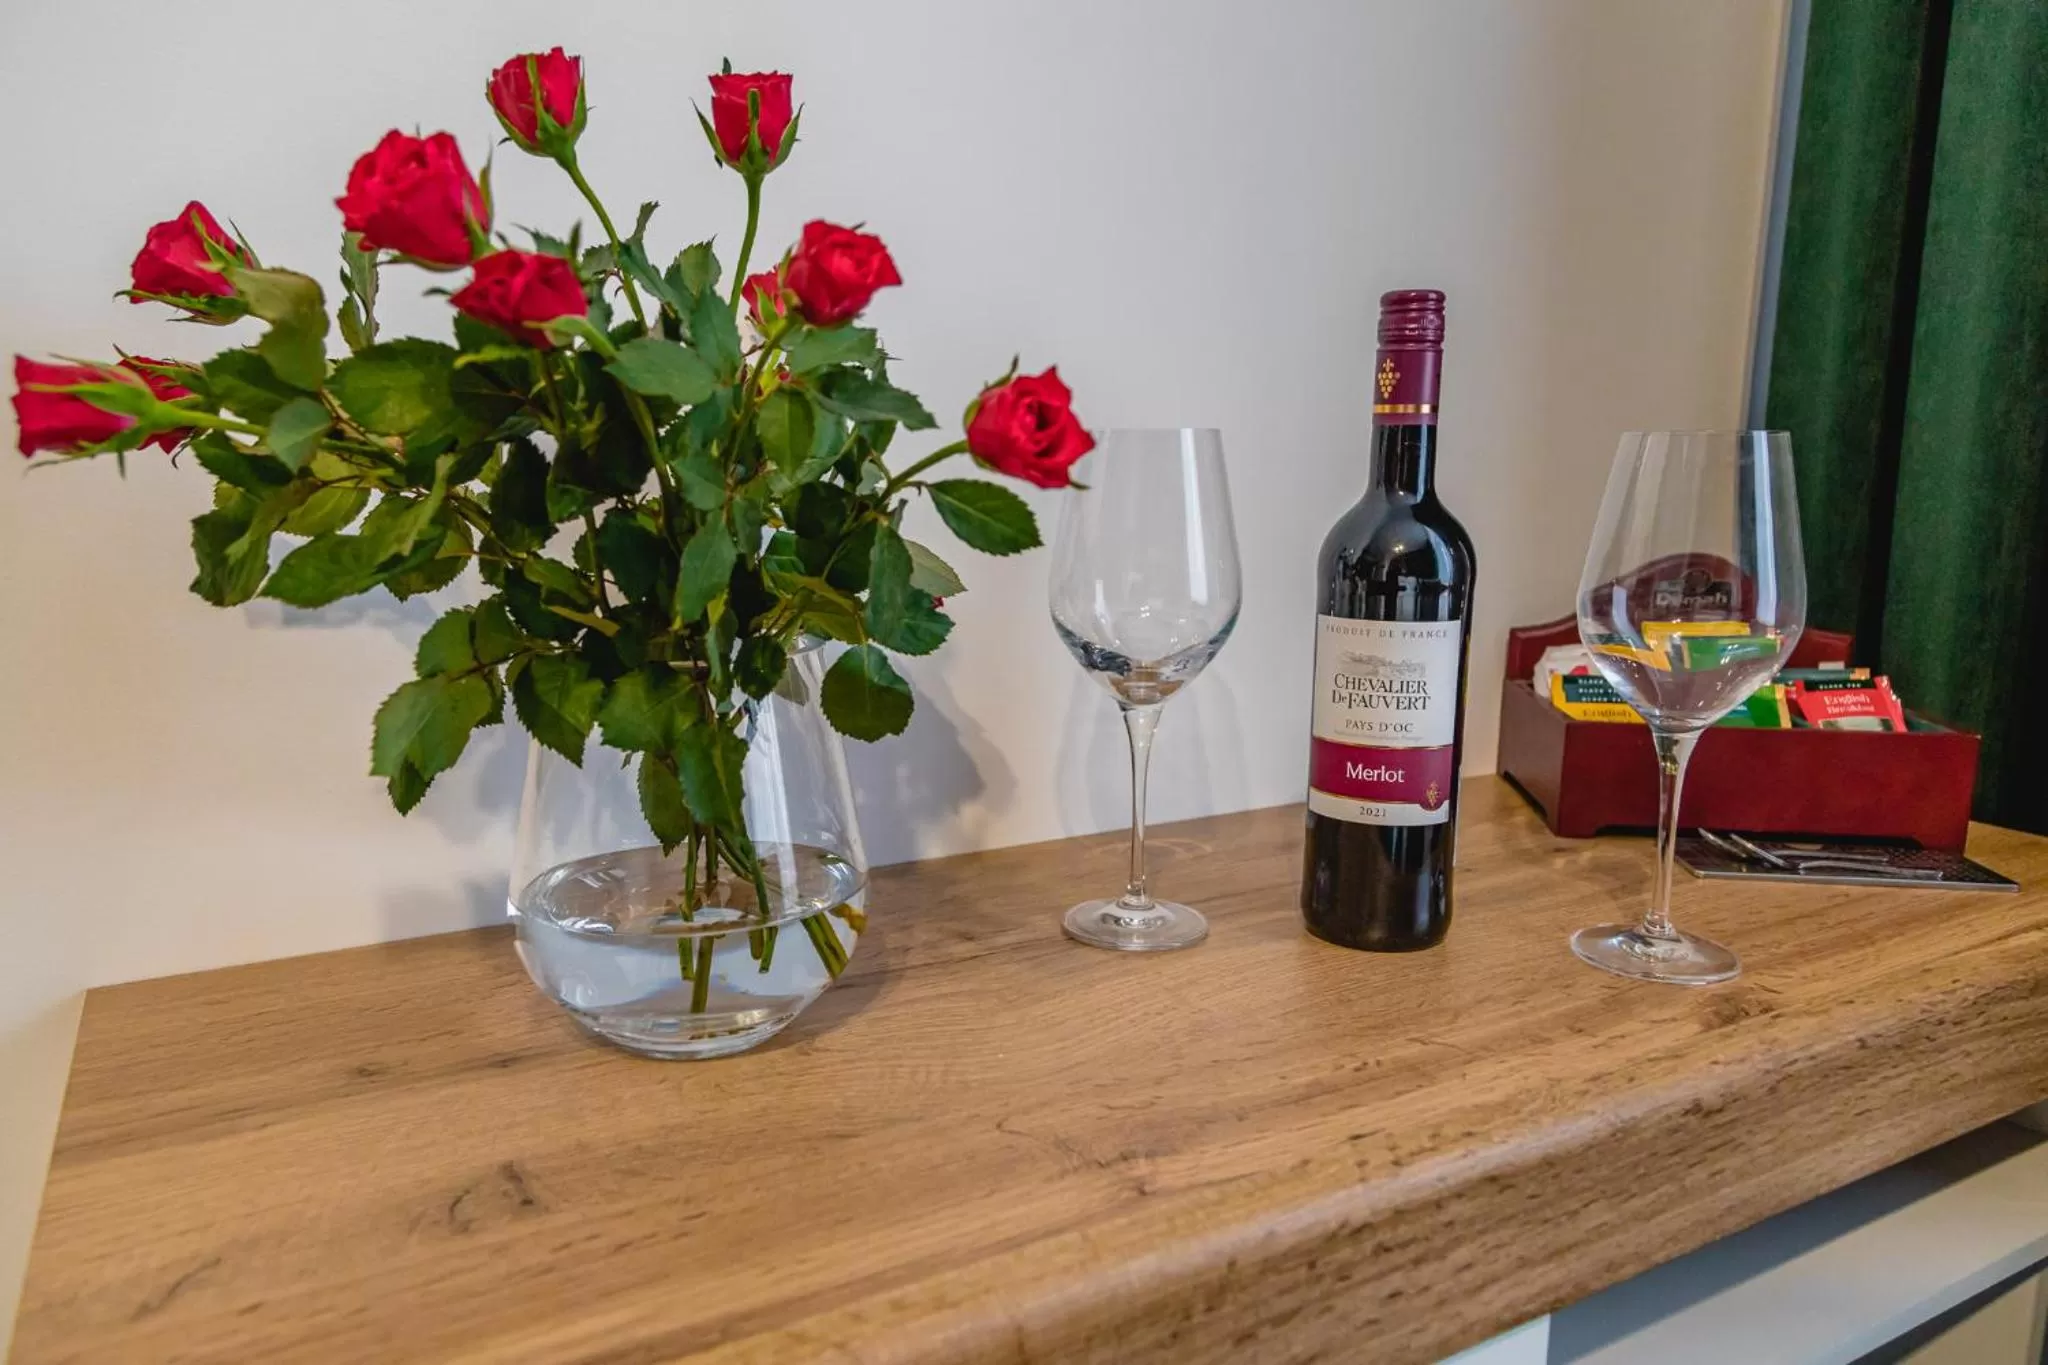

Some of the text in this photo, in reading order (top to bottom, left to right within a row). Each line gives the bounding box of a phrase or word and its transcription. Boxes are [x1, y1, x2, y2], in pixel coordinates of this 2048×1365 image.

[1402, 629, 1448, 639] FRANCE
[1334, 673, 1428, 696] CHEVALIER
[1824, 694, 1870, 706] English
[1345, 719, 1373, 731] PAYS
[1346, 762, 1405, 783] Merlot
[1359, 806, 1387, 817] 2021
